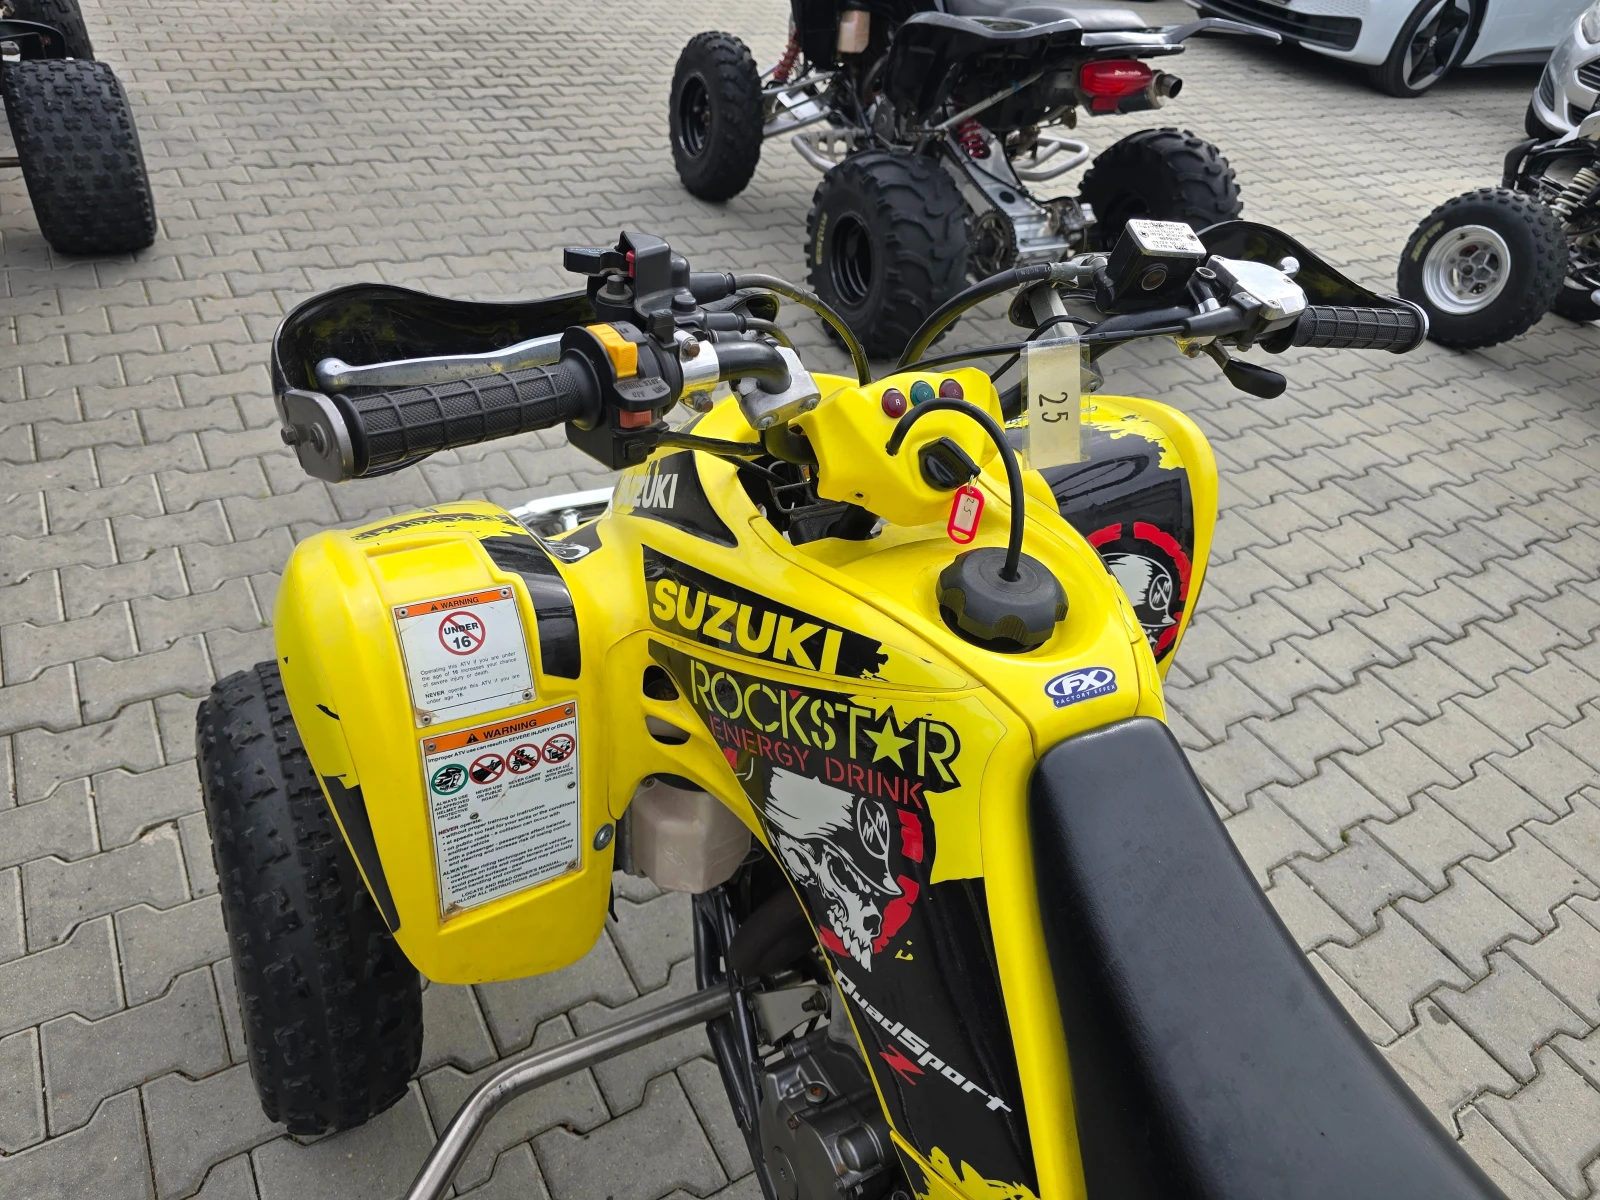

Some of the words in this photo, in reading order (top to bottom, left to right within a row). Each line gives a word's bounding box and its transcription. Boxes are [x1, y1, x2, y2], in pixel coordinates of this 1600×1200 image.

[1038, 391, 1070, 424] 25
[440, 596, 478, 608] WARNING
[443, 622, 478, 635] UNDER
[652, 578, 843, 675] SUZUKI
[452, 634, 471, 649] 16
[420, 665, 445, 675] Operating
[460, 664, 484, 672] increases
[1060, 669, 1106, 696] FX
[425, 690, 444, 698] NEVER
[447, 685, 467, 694] operate
[1055, 690, 1090, 706] FACTORY
[483, 718, 536, 739] WARNING
[428, 752, 453, 764] Improper
[508, 732, 530, 742] SEVERE
[530, 726, 550, 735] INJURY
[556, 720, 574, 728] DEATH
[709, 714, 810, 771] ENERGY
[825, 757, 924, 810] DRINK
[508, 777, 524, 785] NEVER
[509, 776, 540, 788] PASSENGERS
[484, 788, 502, 796] PUBLIC
[436, 797, 457, 806] ALWAYS
[442, 798, 469, 808] APPROVED
[436, 806, 456, 815] HELMET
[437, 807, 467, 819] PROTECTIVE
[438, 825, 458, 835] NEVER
[459, 818, 482, 828] operate:
[445, 828, 466, 838] without
[467, 822, 486, 831] proper
[487, 815, 508, 825] training
[516, 803, 545, 816] instruction
[461, 886, 483, 897] LOCATE
[497, 876, 512, 884] READ
[513, 867, 536, 878] OWNER'S
[835, 969, 1012, 1112] QuadSport
[879, 1043, 925, 1086] Z
